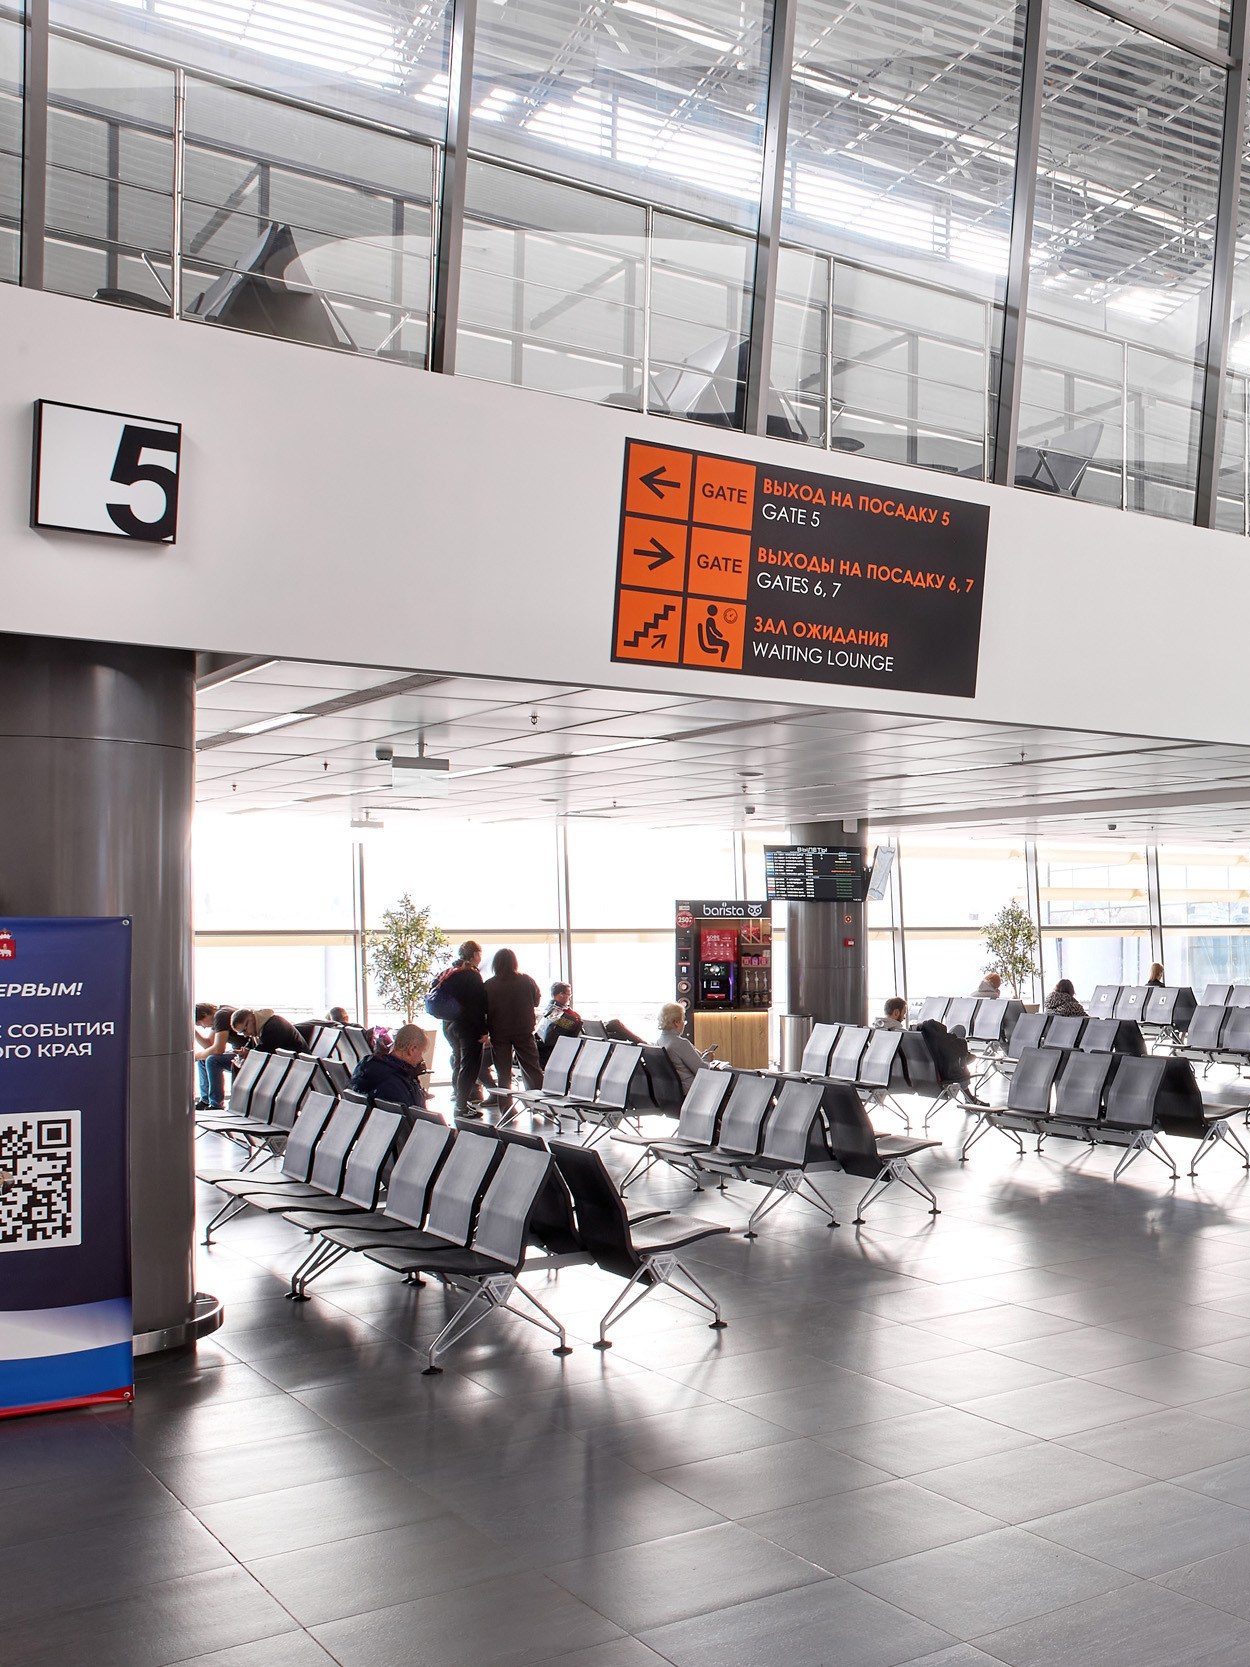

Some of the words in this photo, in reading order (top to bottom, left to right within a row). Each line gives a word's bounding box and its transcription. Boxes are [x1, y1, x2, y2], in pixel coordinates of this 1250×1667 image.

[106, 424, 181, 541] 5
[701, 482, 748, 504] GATE
[763, 477, 827, 506] ВЫХОД
[830, 490, 853, 509] НА
[858, 495, 938, 524] ПОСАДКУ
[941, 511, 950, 526] 5
[762, 503, 807, 526] GATE
[810, 511, 821, 528] 5
[697, 554, 742, 574] GATE
[757, 546, 835, 574] ВЫХОДЫ
[839, 561, 862, 577] НА
[866, 563, 946, 589] ПОСАДКУ
[948, 576, 962, 594] 6,
[965, 578, 975, 594] 7
[756, 571, 809, 596] GATES
[813, 580, 828, 599] 6,
[832, 582, 842, 598] 7
[753, 615, 788, 636] ЗАЛ
[792, 621, 889, 647] ОЖИДАНИЯ
[752, 641, 823, 664] WAITING
[827, 649, 894, 672] LOUNGE
[703, 901, 745, 916] barista
[7, 1021, 115, 1039] СОБЫТИЯ
[0, 1043, 32, 1060] ГО
[37, 1041, 92, 1059] КРАЯ
